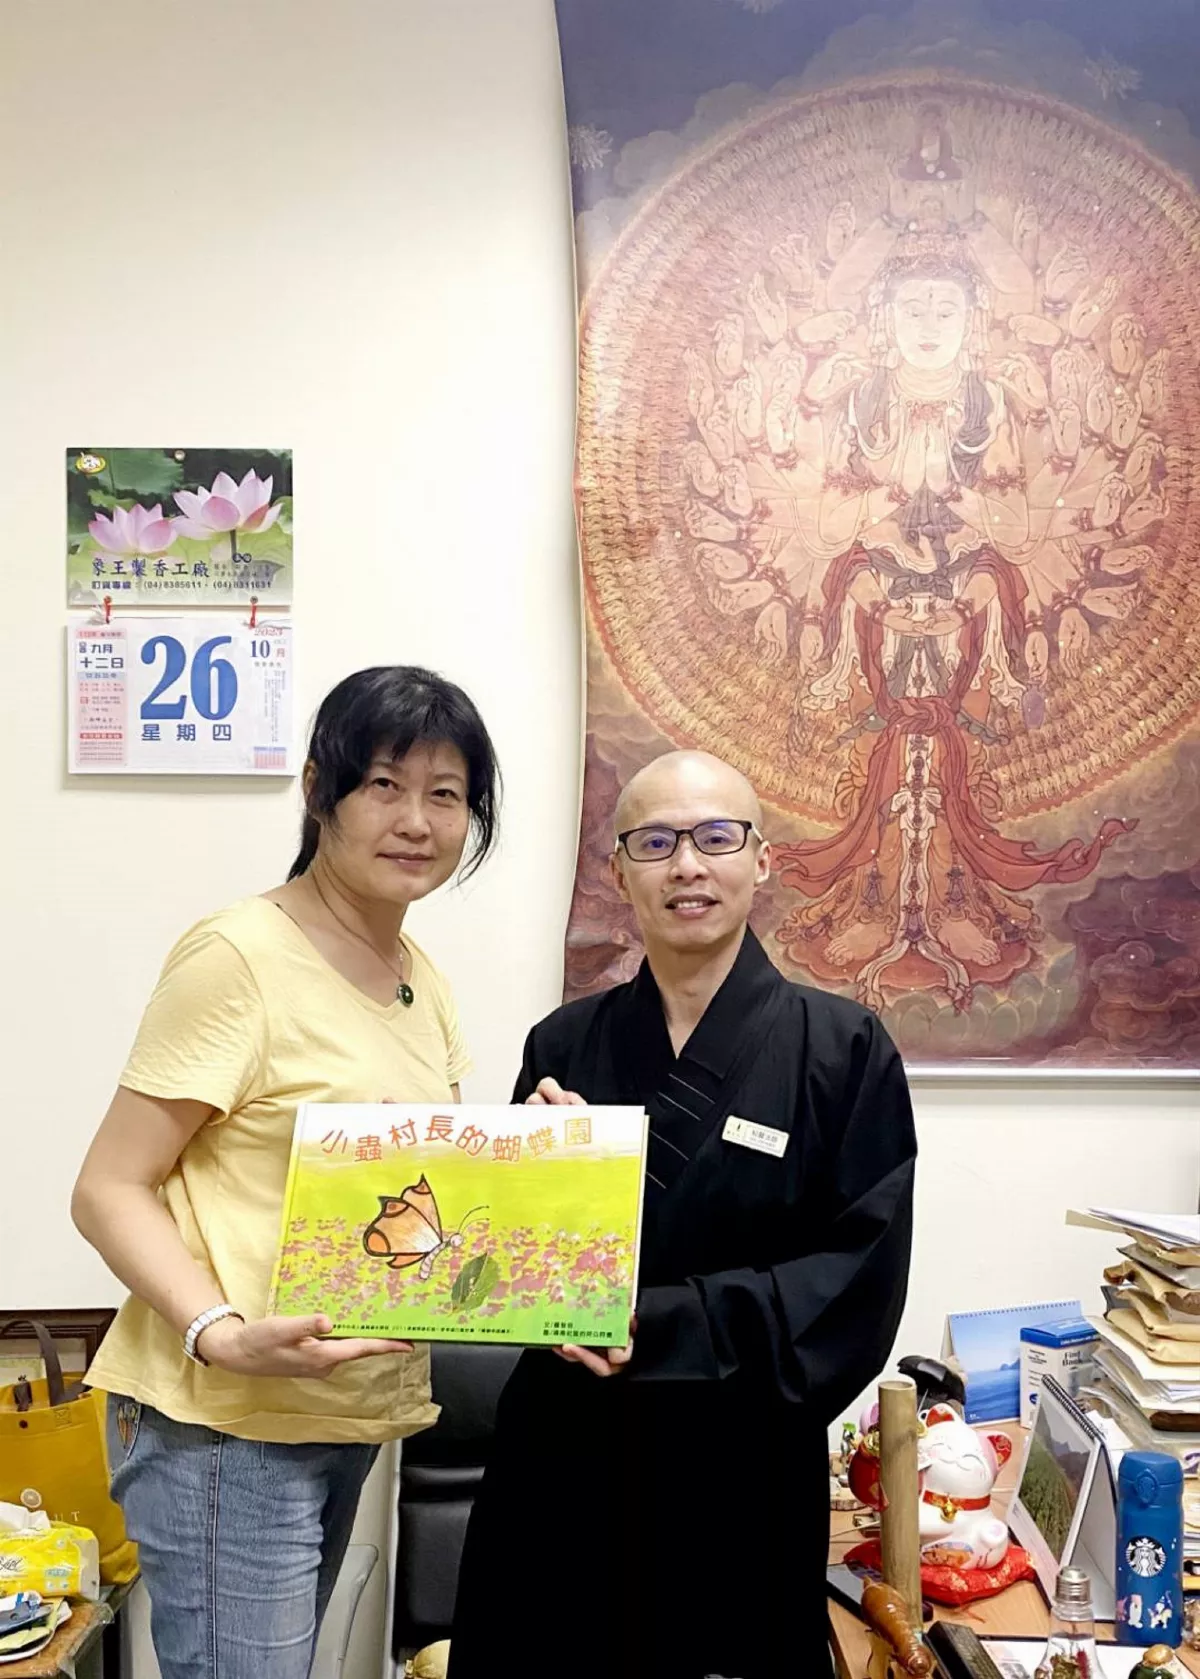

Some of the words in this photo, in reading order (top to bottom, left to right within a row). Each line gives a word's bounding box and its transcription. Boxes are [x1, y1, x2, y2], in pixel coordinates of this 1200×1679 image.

[250, 640, 270, 658] 10
[80, 656, 124, 669] 十二日
[140, 635, 238, 721] 26
[141, 723, 232, 741] 星期四
[320, 1115, 592, 1162] 小蟲村長的蝴蝶園
